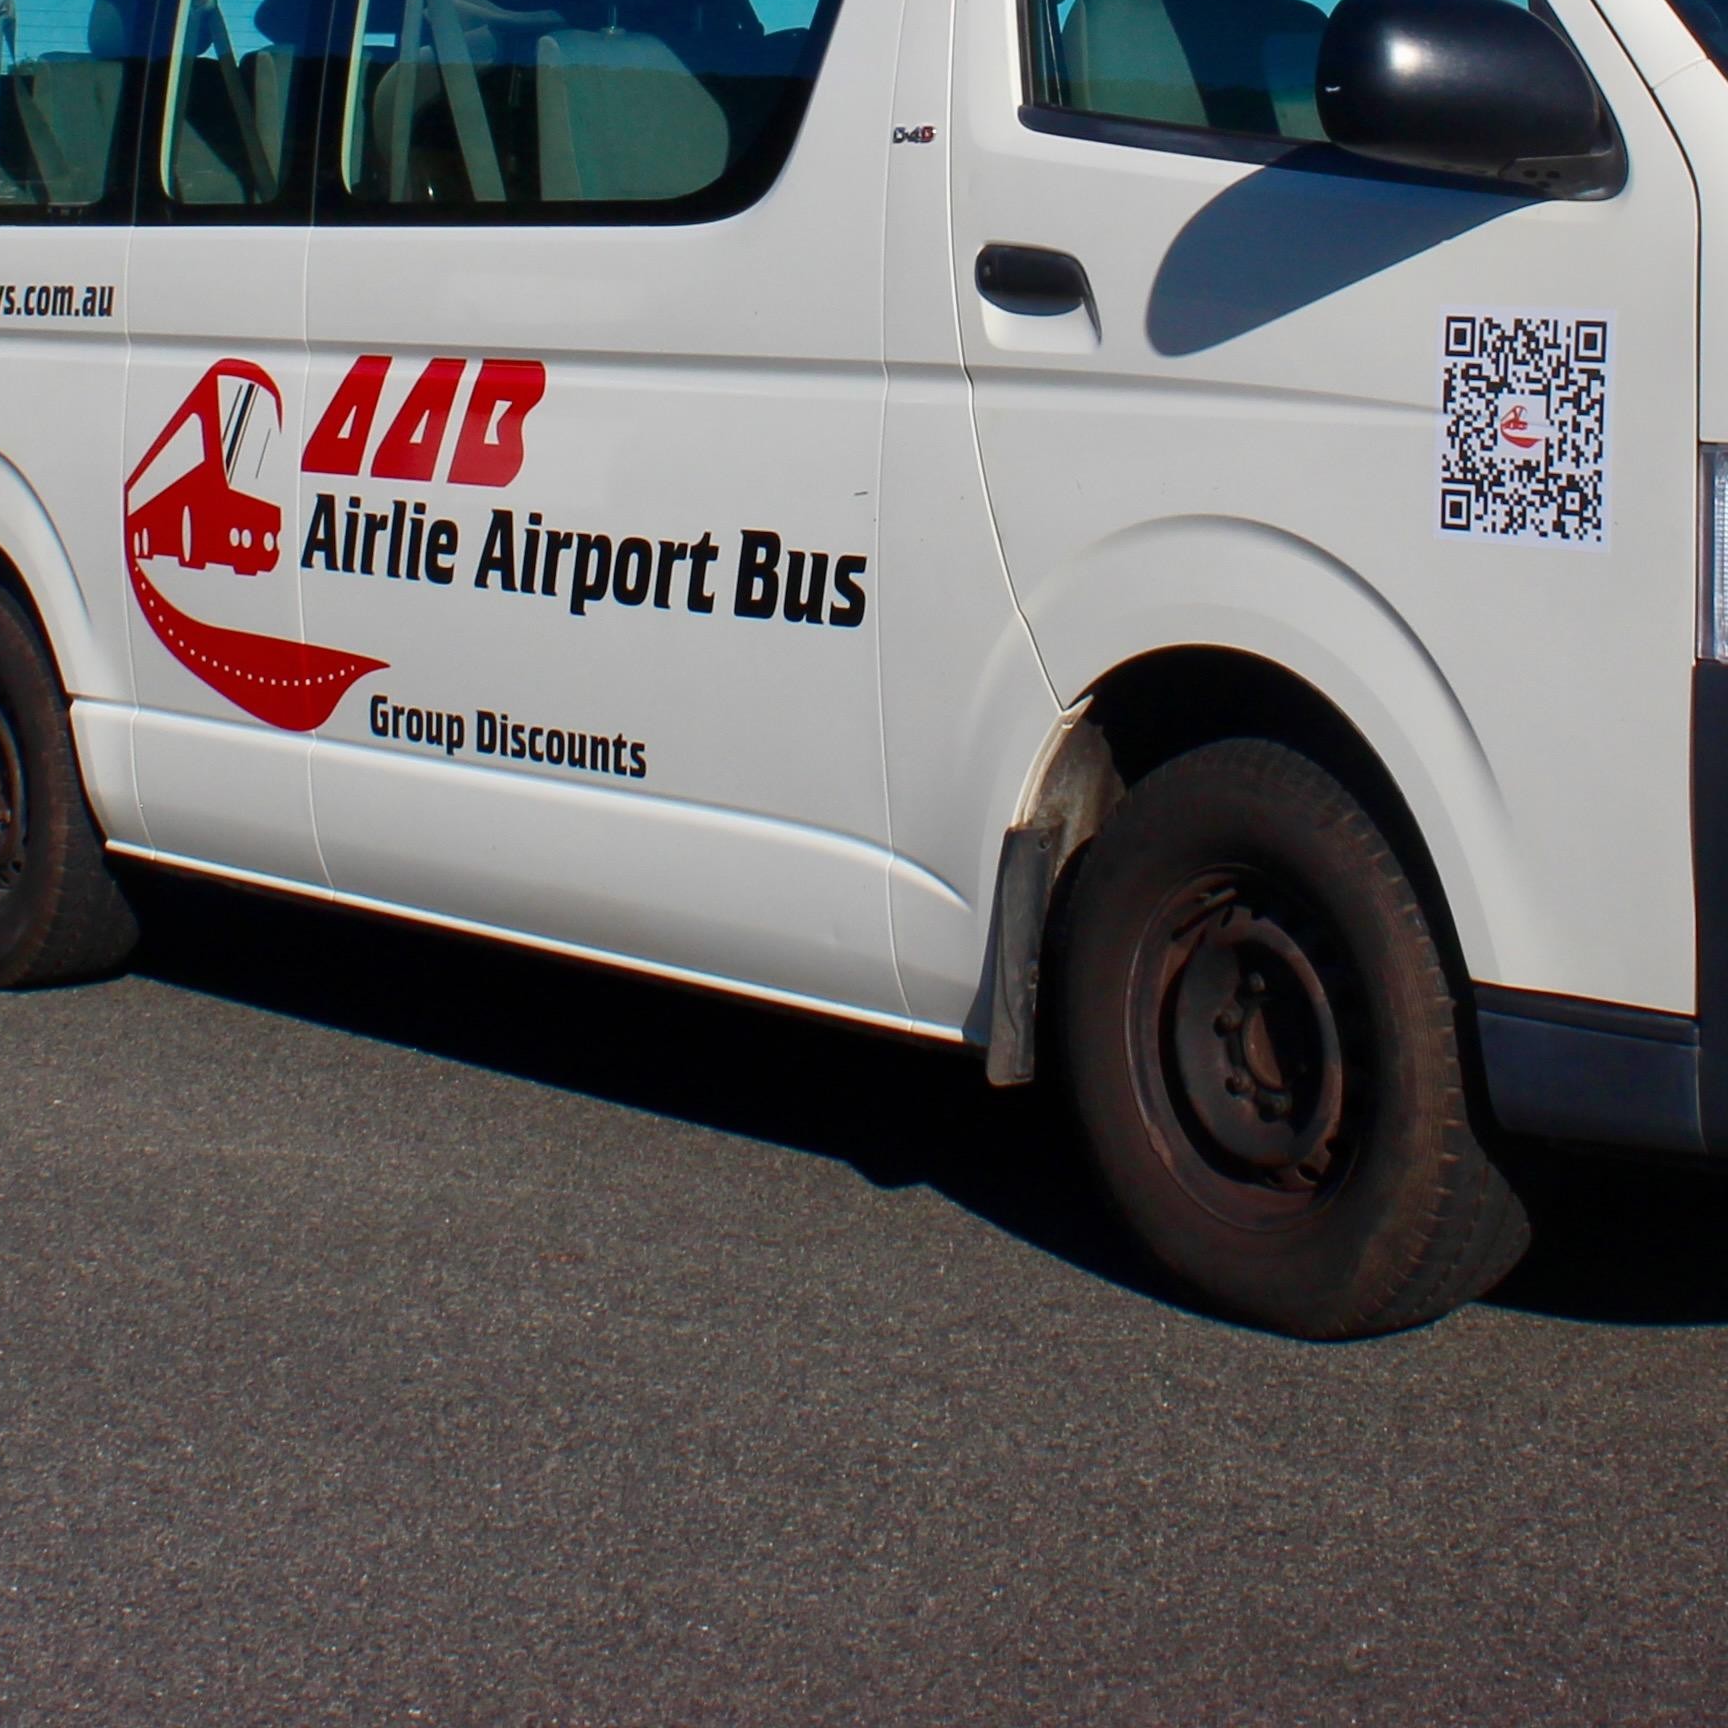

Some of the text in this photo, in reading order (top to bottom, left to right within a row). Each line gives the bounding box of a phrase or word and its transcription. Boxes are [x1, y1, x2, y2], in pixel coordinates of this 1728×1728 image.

[301, 355, 547, 487] AAB
[301, 494, 867, 627] Airlie Airport Bus
[370, 694, 646, 778] Group Discounts
